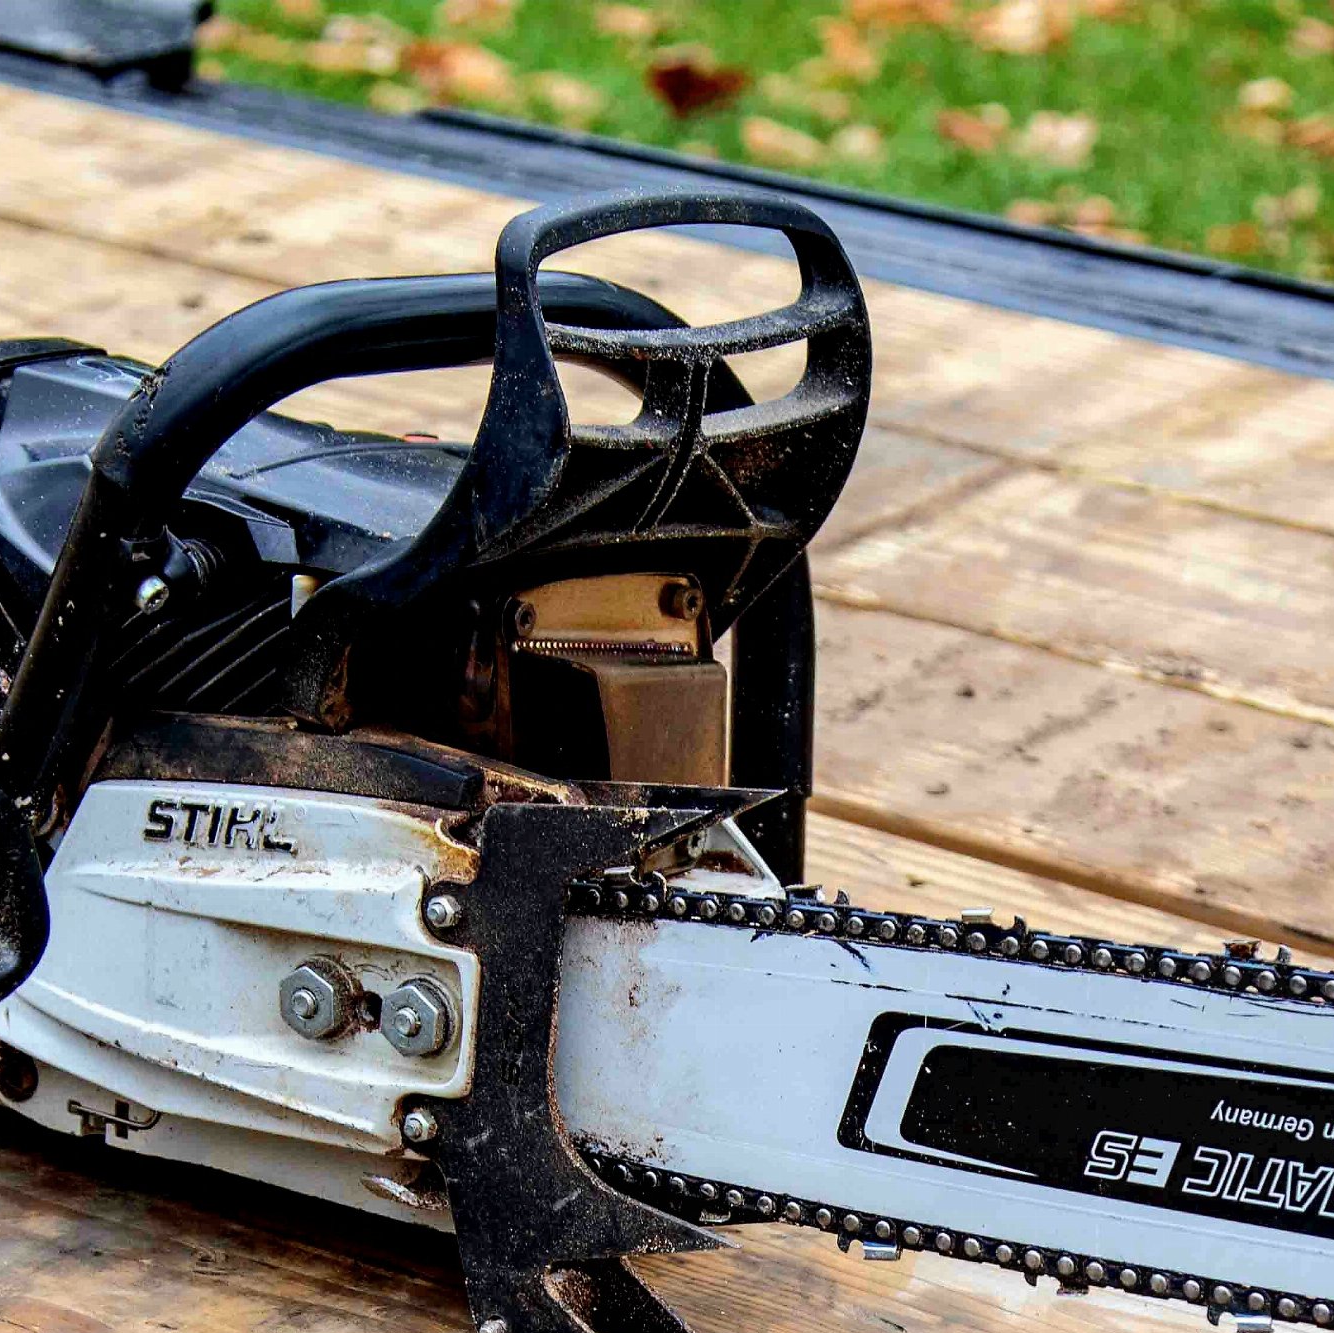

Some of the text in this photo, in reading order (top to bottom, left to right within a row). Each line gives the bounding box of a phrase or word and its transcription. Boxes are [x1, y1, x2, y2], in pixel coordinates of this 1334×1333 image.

[144, 798, 299, 854] STIHL
[1210, 1099, 1315, 1142] Germany
[1083, 1129, 1182, 1189] ES
